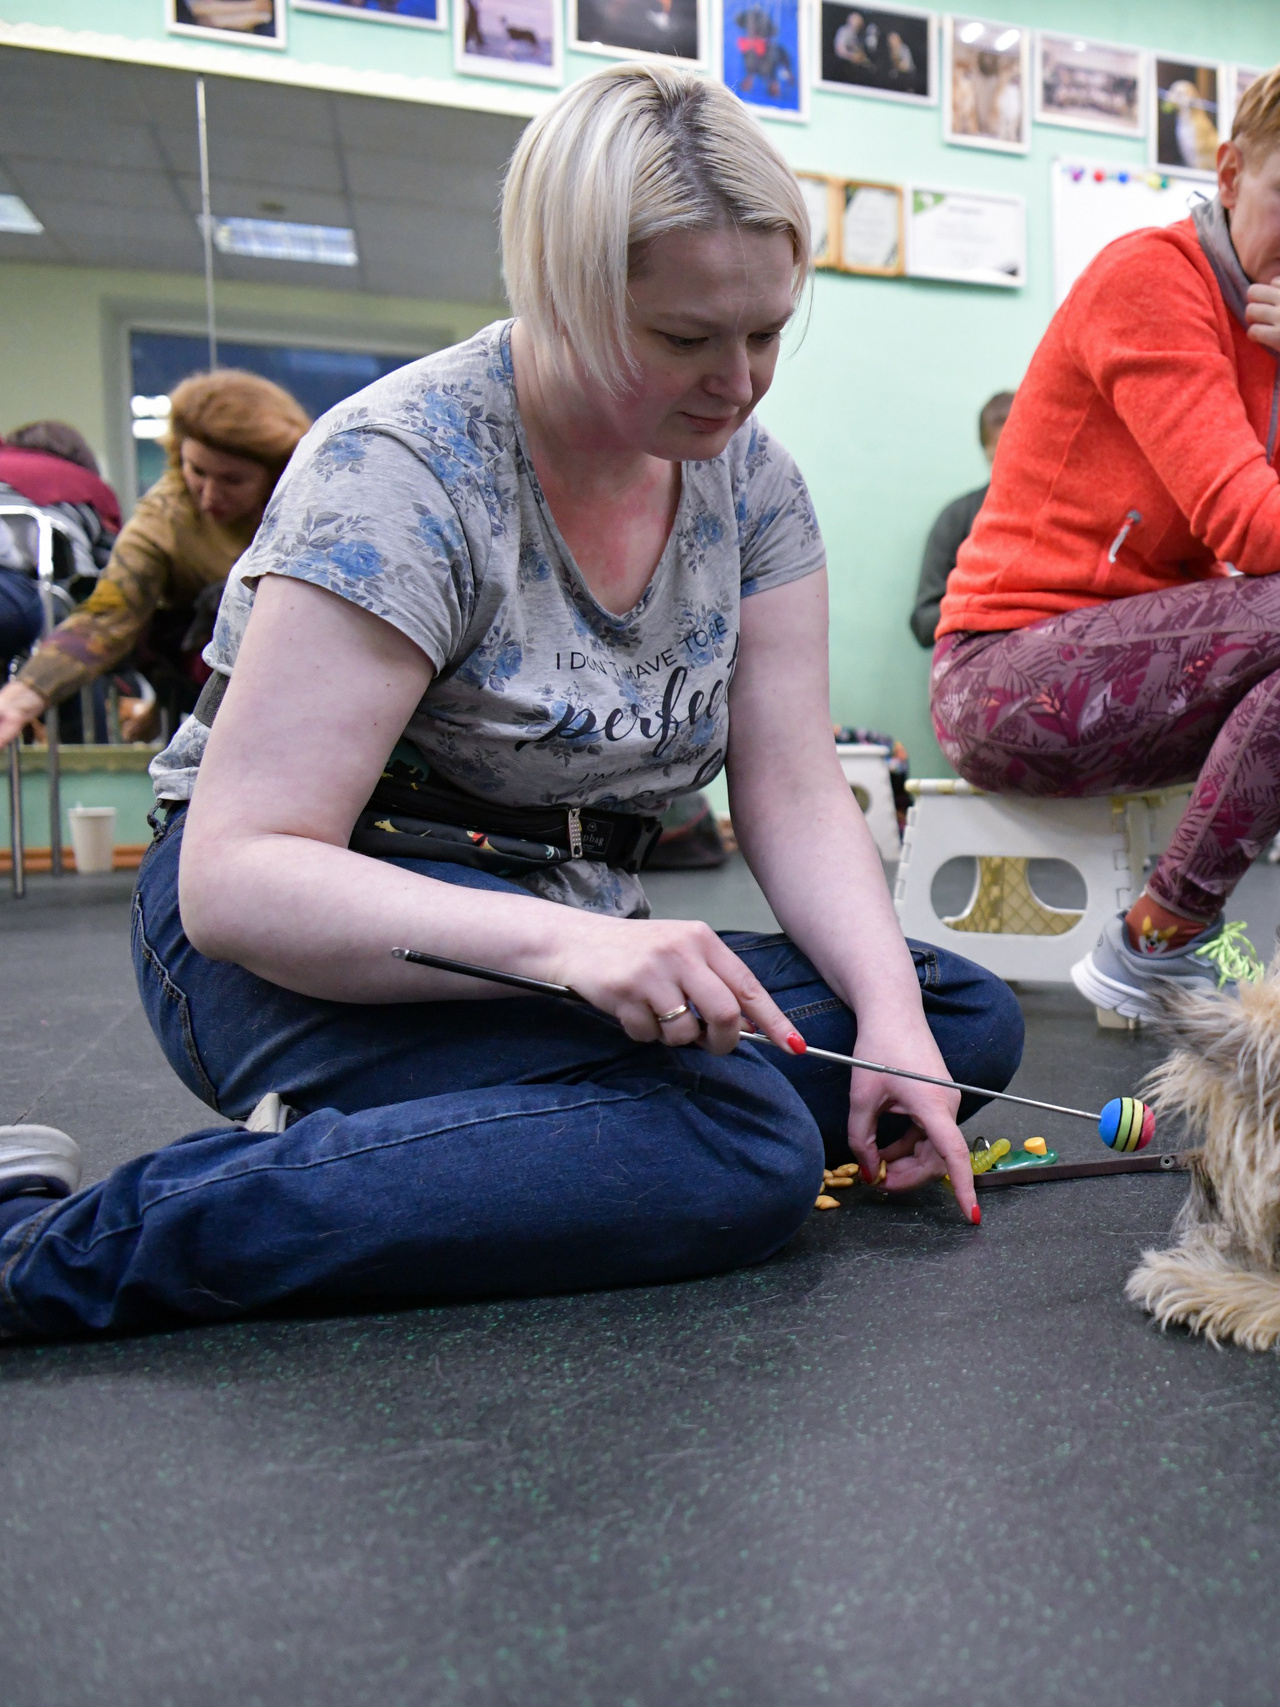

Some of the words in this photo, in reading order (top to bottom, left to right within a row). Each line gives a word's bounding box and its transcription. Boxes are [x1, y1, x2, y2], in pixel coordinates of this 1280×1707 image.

[556, 652, 561, 670] I
[626, 648, 678, 680] HAVE
[678, 629, 709, 654] TO
[708, 616, 728, 640] BE
